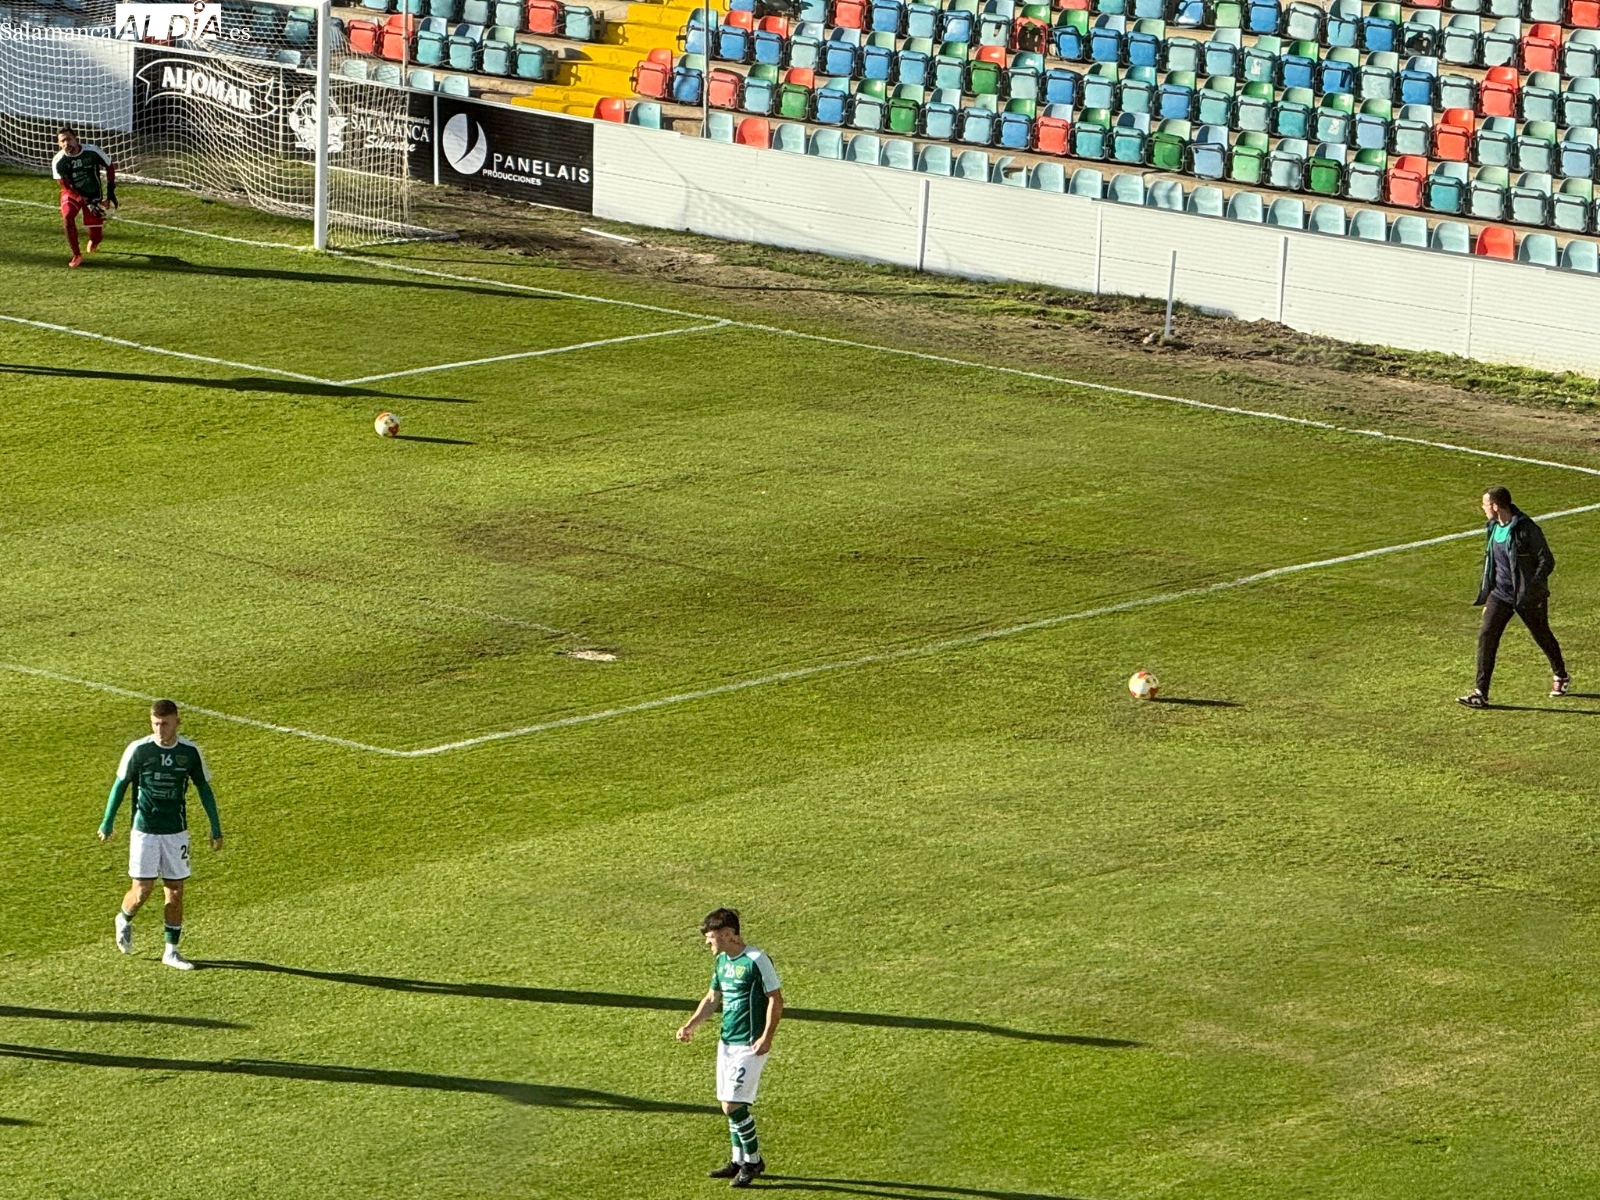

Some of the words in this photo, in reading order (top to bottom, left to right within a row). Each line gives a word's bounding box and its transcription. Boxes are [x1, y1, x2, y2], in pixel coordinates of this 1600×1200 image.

[162, 66, 253, 112] ALJOMAR
[350, 114, 430, 143] SALAMANCA
[493, 152, 590, 184] PANELAIS
[482, 168, 542, 187] PRODUCCIONES
[160, 753, 173, 767] 16
[180, 844, 190, 860] 2
[724, 963, 736, 979] 26
[729, 1066, 746, 1084] 22
